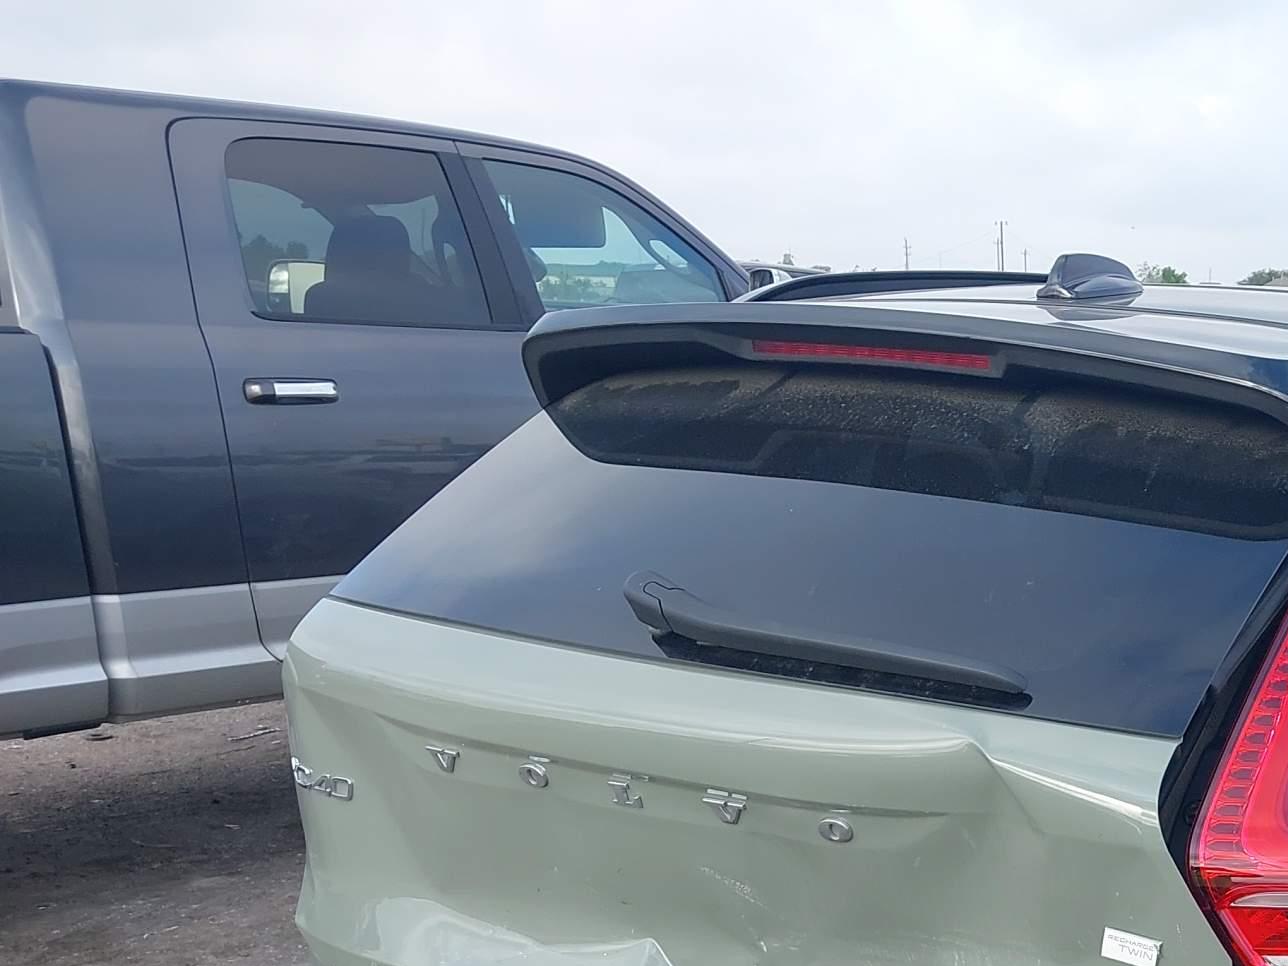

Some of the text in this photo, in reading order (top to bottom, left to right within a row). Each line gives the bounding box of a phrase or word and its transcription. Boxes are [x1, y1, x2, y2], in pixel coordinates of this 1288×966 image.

[425, 744, 854, 842] VOLVO
[1107, 934, 1154, 952] RECHARGE
[1119, 944, 1153, 960] TWIN
